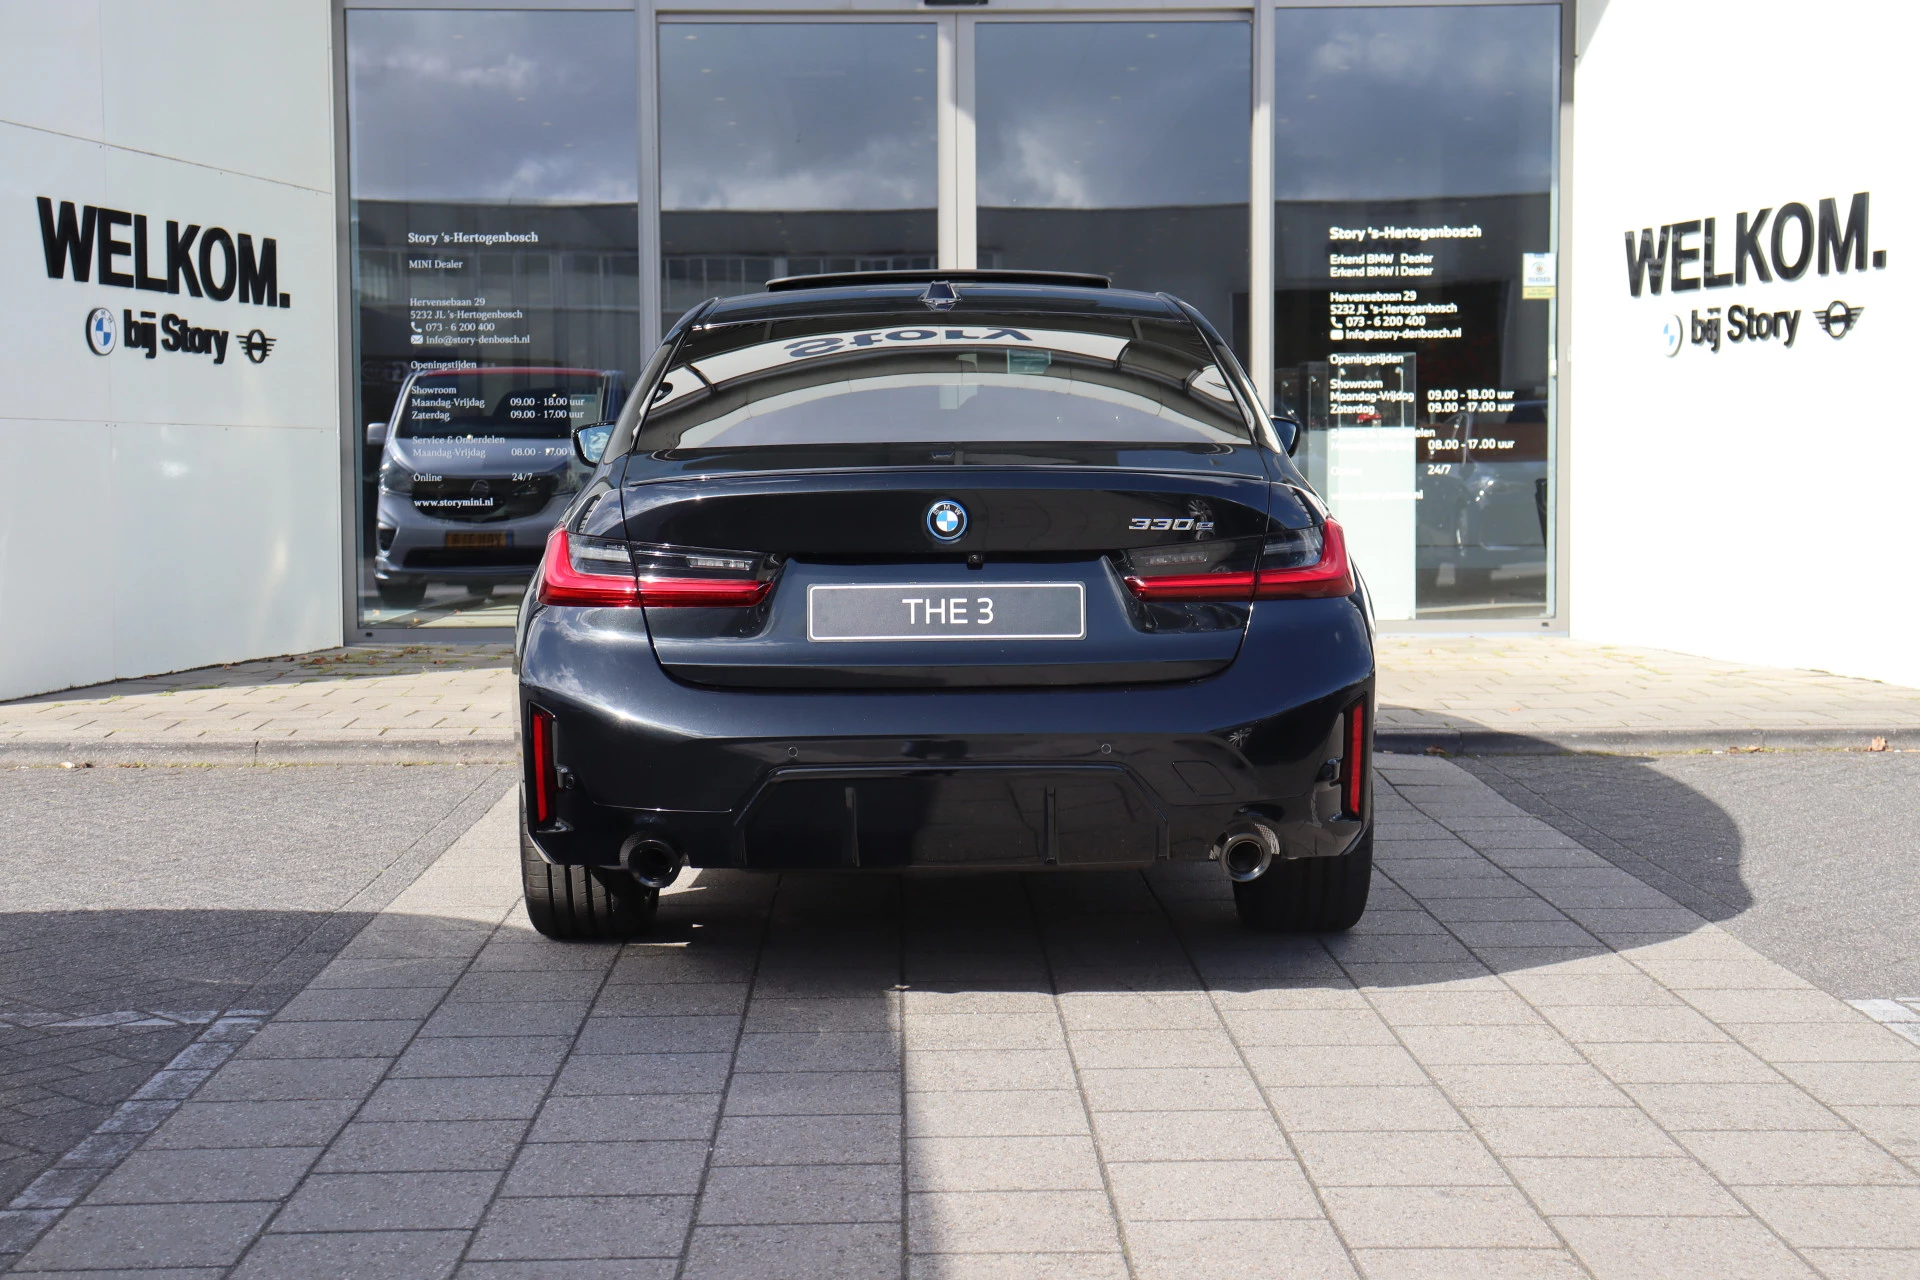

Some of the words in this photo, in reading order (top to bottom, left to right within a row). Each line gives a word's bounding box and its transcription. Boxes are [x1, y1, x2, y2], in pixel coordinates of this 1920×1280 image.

[408, 232, 438, 245] Story
[1329, 227, 1365, 241] Story
[1368, 225, 1481, 241] 's-Hertogenbosch
[1625, 191, 1887, 298] WELKOM.
[36, 196, 290, 308] WELKOM.
[409, 260, 432, 268] MINI
[434, 260, 463, 268] Dealer
[1330, 254, 1365, 264] Erkend
[1367, 254, 1393, 264] BMW
[1401, 253, 1433, 263] Dealer
[1330, 267, 1365, 277] Erkend
[1367, 266, 1394, 277] BMW
[1395, 266, 1399, 276] i
[1400, 266, 1433, 276] Dealer
[410, 298, 472, 306] Hervensebaan
[474, 298, 485, 306] 29
[1330, 291, 1401, 302] Hervensebaan
[1403, 291, 1417, 301] 29
[410, 310, 432, 319] 5232
[435, 311, 445, 320] JL
[1330, 304, 1355, 315] 5232
[1356, 304, 1368, 316] JL
[426, 323, 442, 331] 073
[450, 323, 456, 331] 6
[459, 323, 476, 331] 200
[478, 323, 495, 331] 400
[1346, 317, 1365, 327] 073
[1374, 316, 1381, 326] 6
[1382, 316, 1403, 326] 200
[1405, 316, 1426, 326] 400
[1727, 304, 1802, 348] Story
[161, 314, 229, 364] Story
[1345, 328, 1461, 341] info@story-denbosch.nl
[426, 335, 530, 346] info@story-denbosch.nl
[1330, 354, 1404, 365] Openingstijden
[411, 361, 477, 371] Openingstijden
[1330, 379, 1383, 389] Showroom
[411, 386, 456, 394] Showroom
[1330, 391, 1414, 403] Maandag-Vrijdag
[1428, 390, 1458, 400] 09.00
[1467, 389, 1495, 400] 18.00
[1497, 391, 1514, 400] uur
[412, 398, 484, 408] Maandag-Vrijdag
[510, 398, 535, 406] 09.00
[544, 398, 567, 406] 18.00
[1330, 404, 1375, 414] Zaterdag
[1428, 403, 1458, 413] 09.00
[1467, 402, 1495, 412] 17.00
[1497, 403, 1515, 412] uur
[412, 411, 450, 421] Zaterdag
[510, 411, 535, 419] 09.00
[544, 410, 567, 418] 17.00
[412, 436, 444, 444] Service
[447, 436, 453, 444] &
[455, 436, 505, 444] Onderdelen
[1428, 440, 1459, 450] 08.00
[1467, 440, 1496, 449] 17.00
[1498, 441, 1515, 449] uur
[413, 449, 486, 458] Maandag-Vrijdag
[511, 448, 536, 456] 08.00
[1428, 465, 1451, 475] 24/7
[414, 473, 442, 481] Online
[512, 473, 532, 482] 24/7
[414, 498, 493, 508] www.storymini.nl
[1128, 518, 1214, 531] 330e
[902, 598, 968, 625] THE
[977, 598, 994, 624] 3
